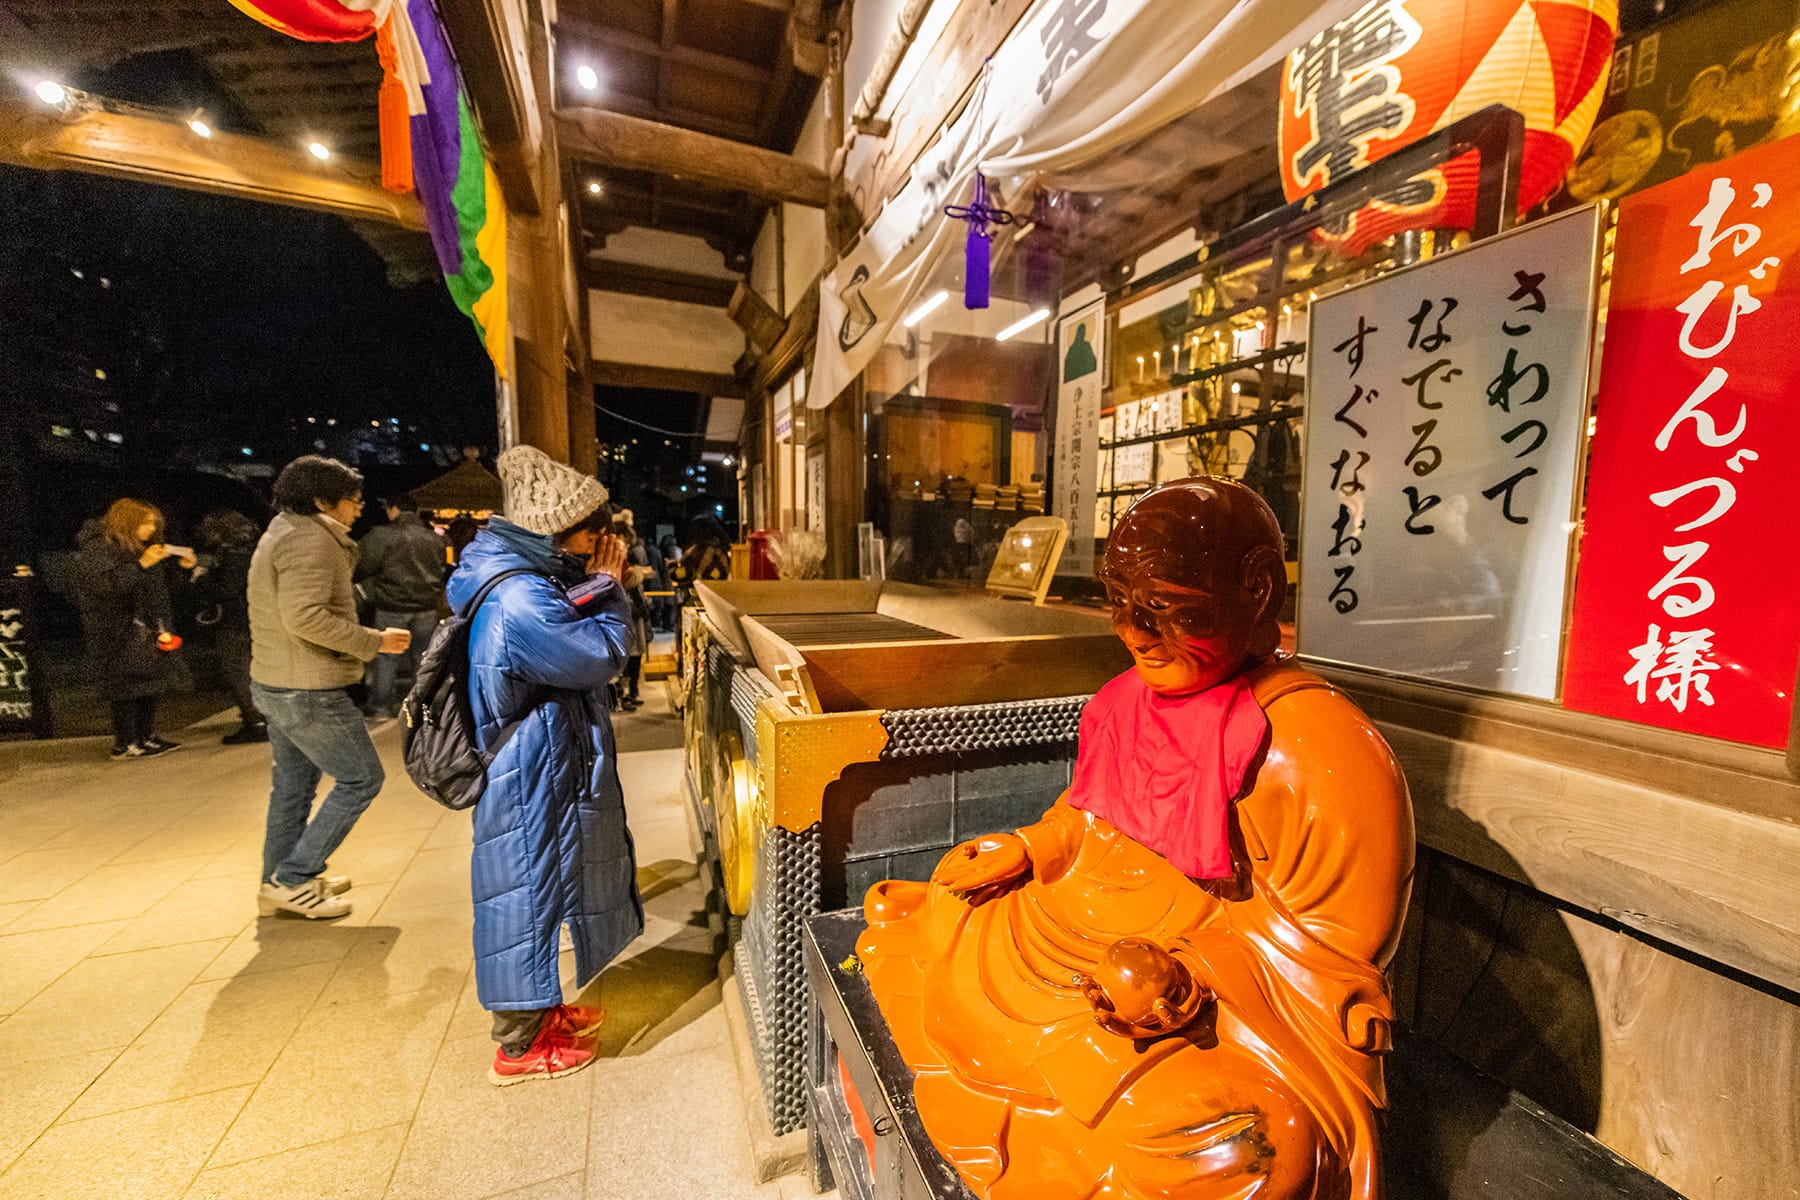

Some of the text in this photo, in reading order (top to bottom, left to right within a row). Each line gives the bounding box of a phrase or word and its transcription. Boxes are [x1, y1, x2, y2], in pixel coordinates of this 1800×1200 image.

[1327, 315, 1380, 615] すぐなおる
[1401, 297, 1463, 536] なでると
[1481, 270, 1550, 525] さわって
[1624, 177, 1780, 713] おびんづる様
